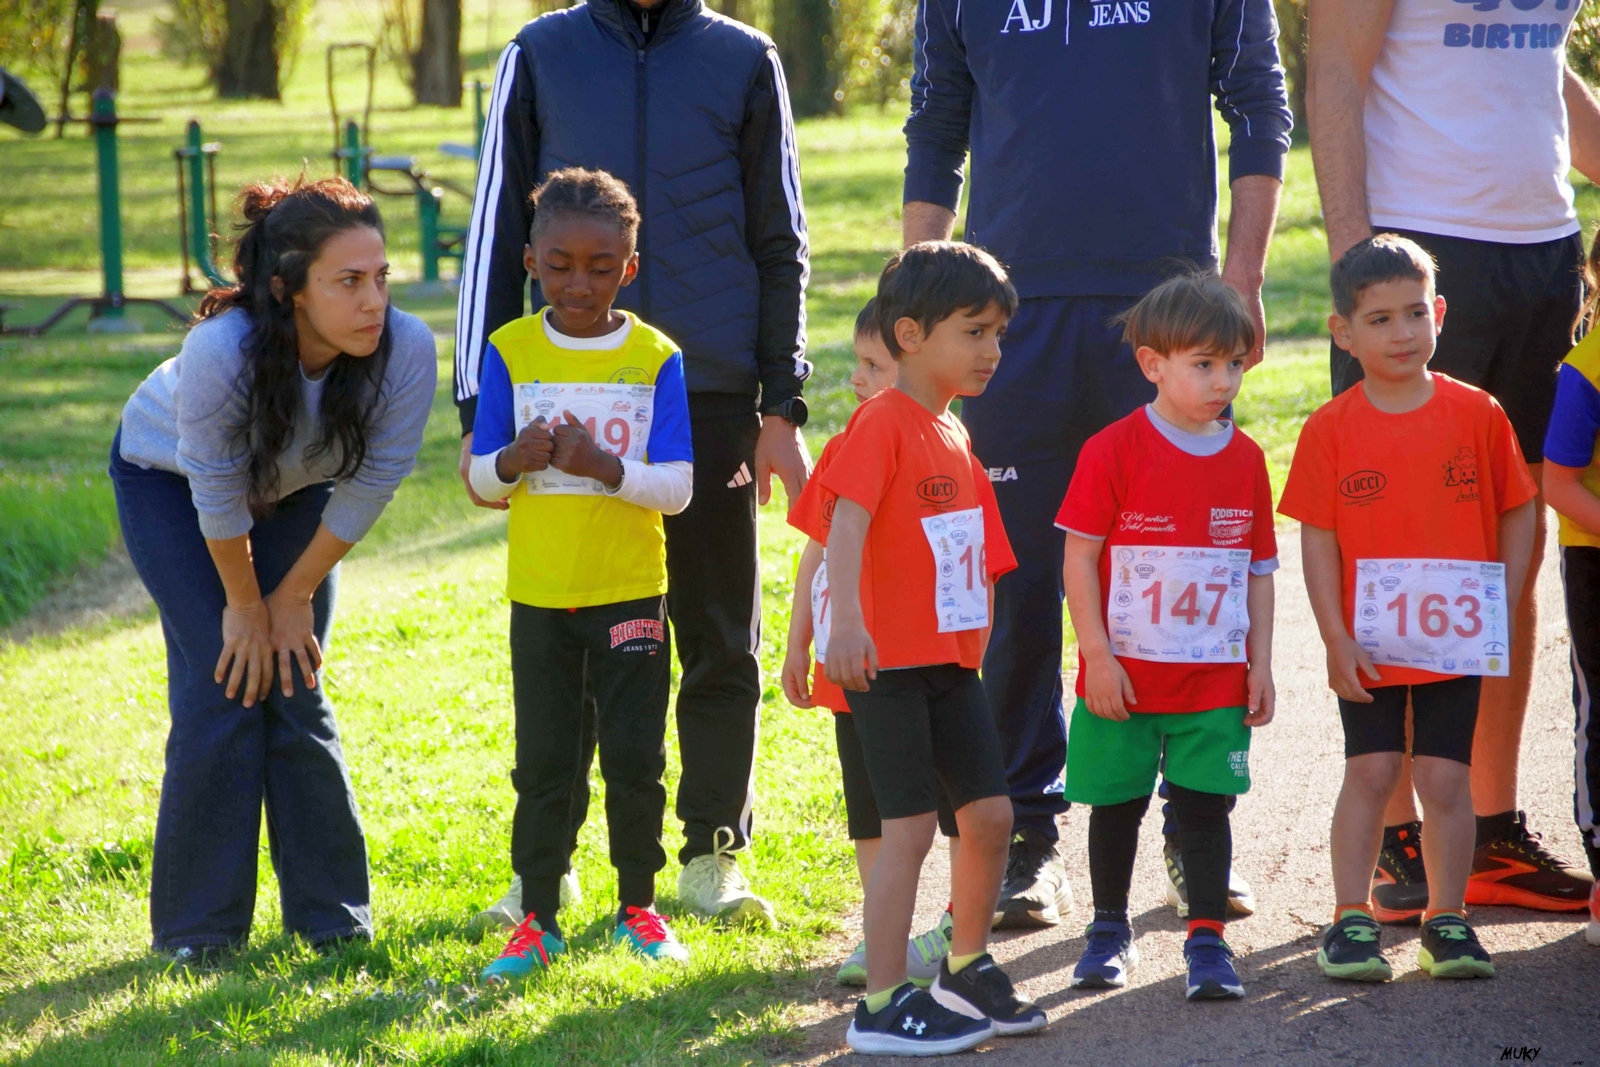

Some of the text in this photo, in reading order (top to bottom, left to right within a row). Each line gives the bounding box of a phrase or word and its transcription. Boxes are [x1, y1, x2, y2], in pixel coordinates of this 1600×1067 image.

[1000, 0, 1052, 33] AJ
[1089, 1, 1151, 27] JEANS
[1443, 23, 1567, 49] BIRTHD
[923, 482, 953, 497] LUCCI
[1346, 475, 1379, 493] LUCCI
[1211, 508, 1254, 521] PODISTICA
[1142, 581, 1228, 626] 147
[1387, 593, 1483, 638] 163
[1227, 751, 1242, 763] THE
